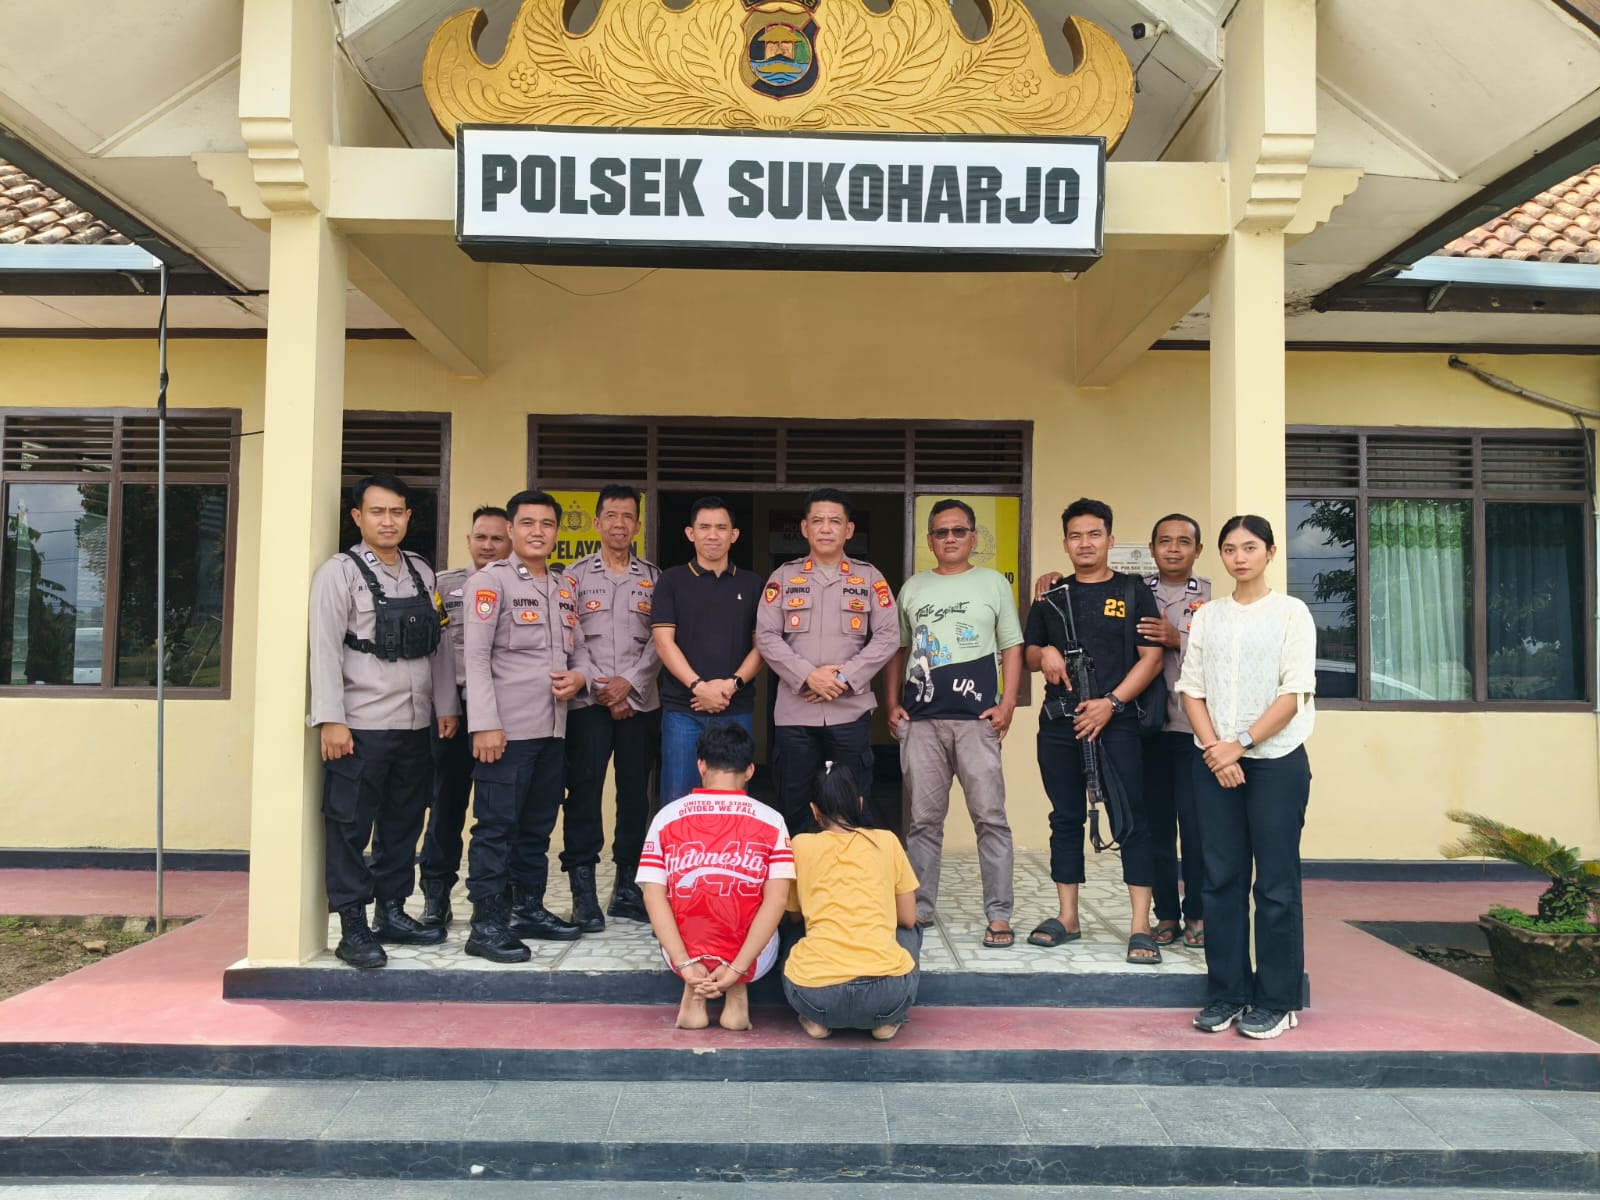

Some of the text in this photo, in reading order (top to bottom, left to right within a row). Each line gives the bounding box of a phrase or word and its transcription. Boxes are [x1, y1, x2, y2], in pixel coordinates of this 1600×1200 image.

[481, 153, 1080, 225] POLSEK SUKOHARJO
[785, 586, 811, 594] JUNIKO
[842, 588, 869, 597] POLRI
[512, 598, 539, 607] SUTINO
[1103, 598, 1126, 618] 23
[683, 800, 712, 808] UNITED
[678, 805, 715, 817] DIVIDED
[735, 806, 757, 817] FALL
[665, 848, 764, 876] Indonesia
